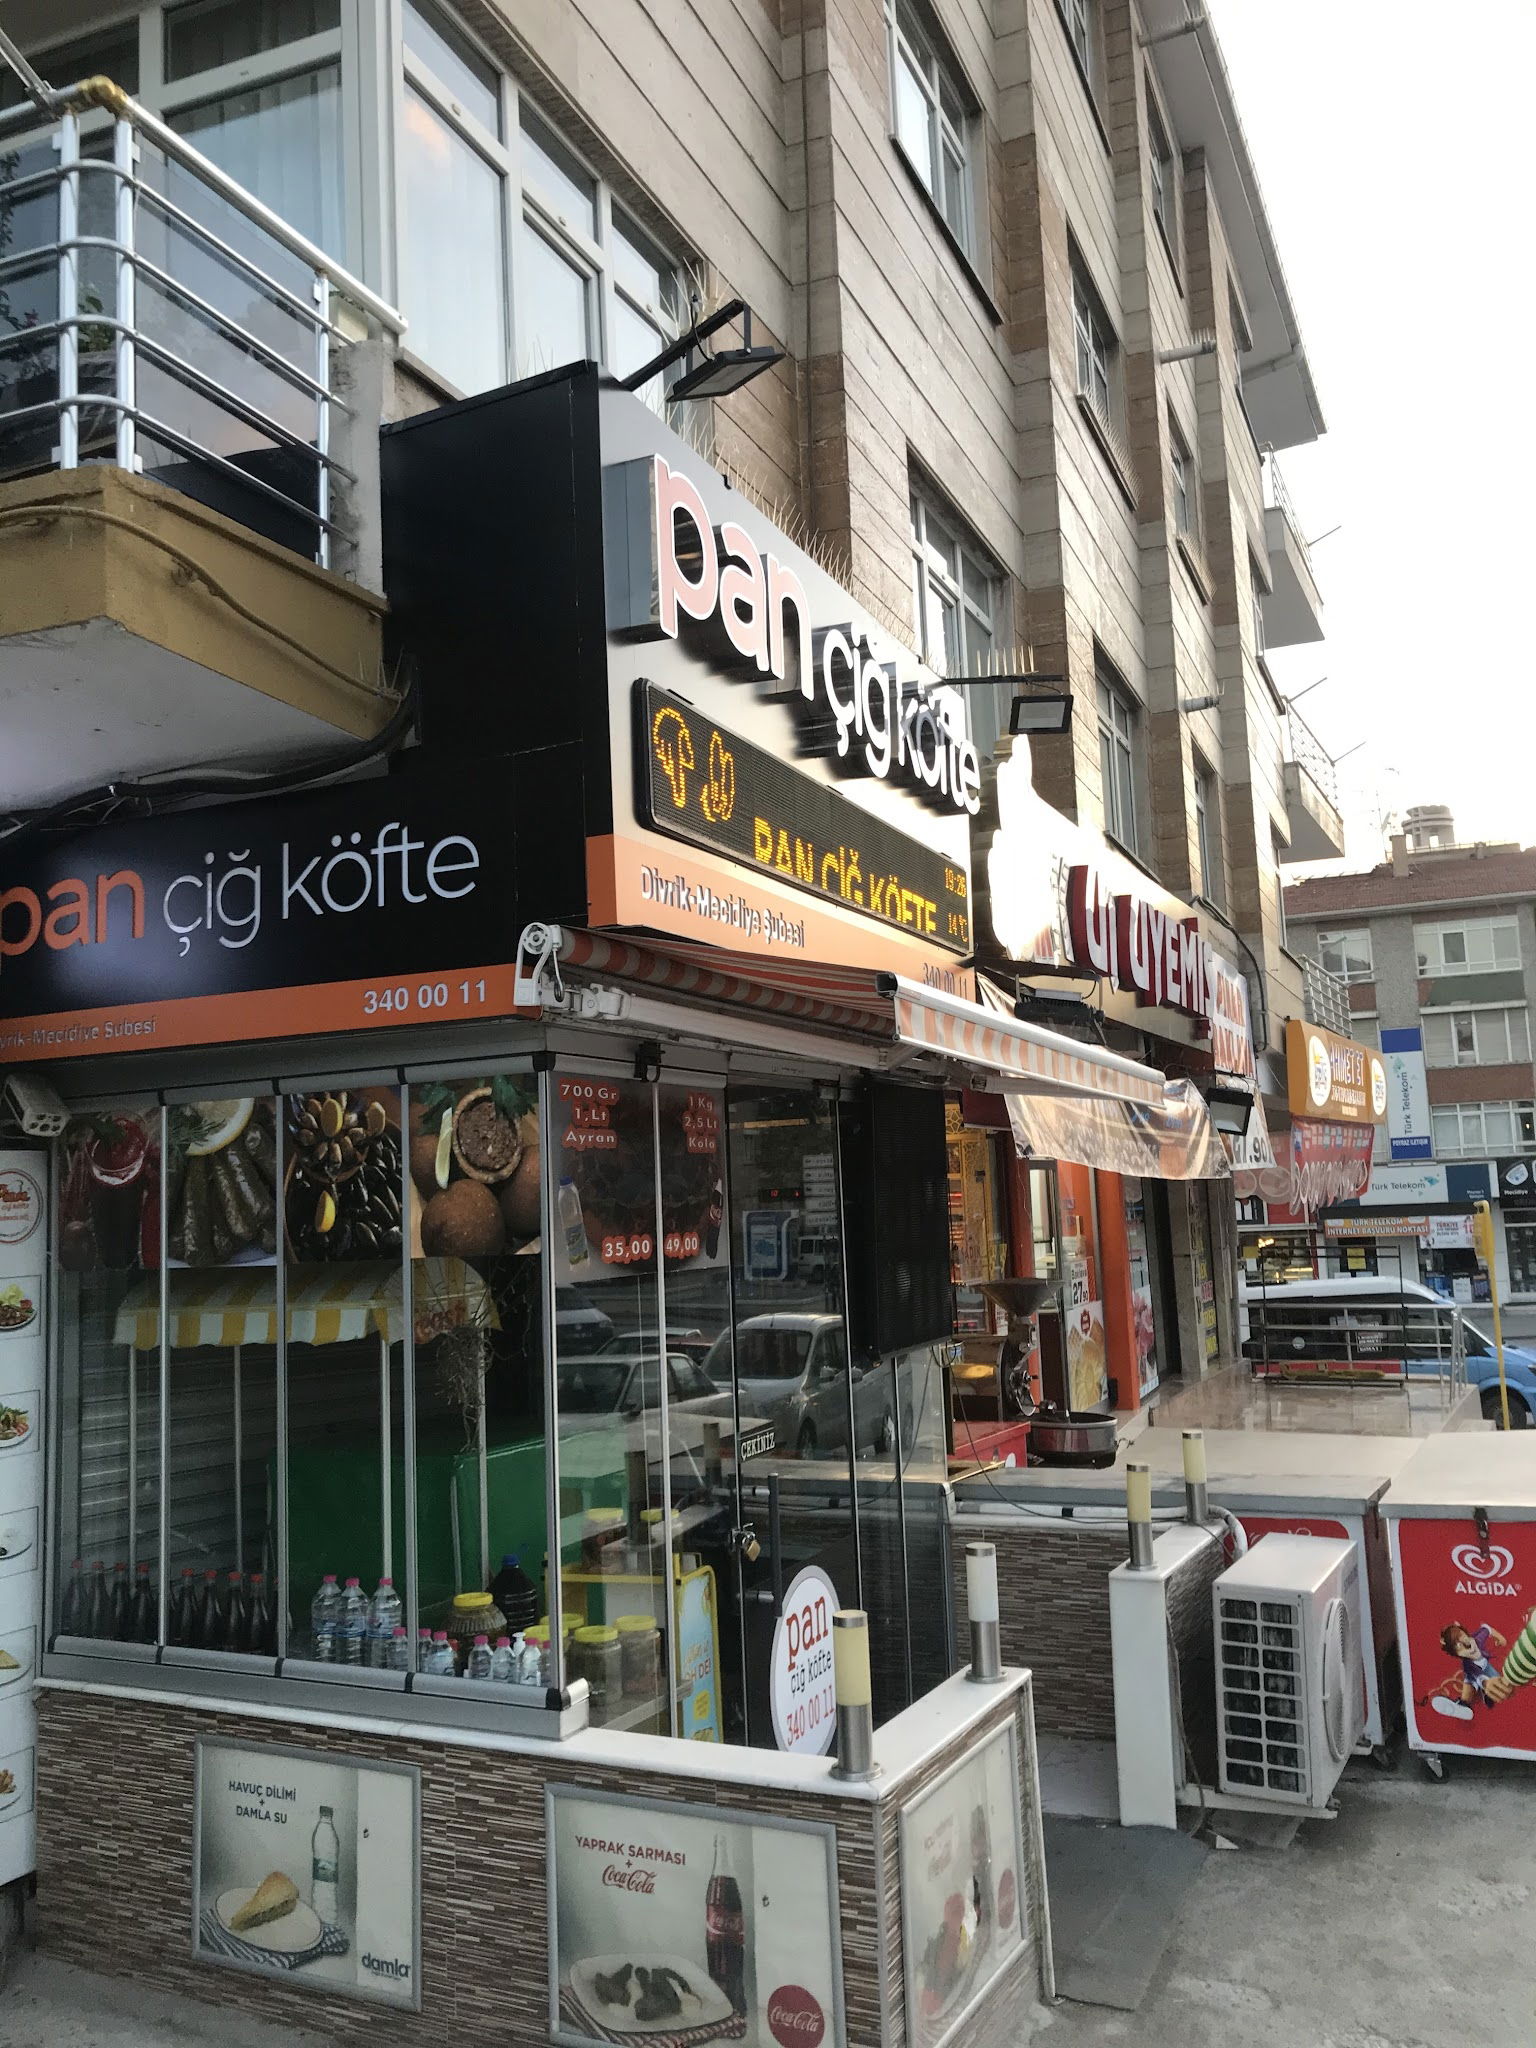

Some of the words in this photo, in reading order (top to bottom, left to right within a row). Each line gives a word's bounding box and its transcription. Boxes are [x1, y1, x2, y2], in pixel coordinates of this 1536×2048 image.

[655, 454, 814, 700] pan
[163, 848, 261, 957] çiğ
[281, 822, 480, 920] köfte
[641, 864, 762, 937] Divrik-Mecidiye
[764, 908, 805, 948] Şubesi
[363, 986, 410, 1015] 340
[417, 984, 450, 1009] 00
[459, 979, 487, 1004] 11
[561, 1084, 593, 1099] 700
[598, 1087, 617, 1100] Gr
[698, 1097, 713, 1112] Kg
[1402, 1072, 1411, 1111] Telekom
[684, 1116, 704, 1129] 2,5
[706, 1118, 717, 1129] Lt
[1404, 1111, 1413, 1135] Türk
[566, 1131, 615, 1145] Ayran
[688, 1137, 715, 1149] Kola
[1392, 1181, 1426, 1190] Telekom
[605, 1239, 650, 1258] 35,00
[666, 1237, 698, 1254] 49,00
[1073, 1281, 1083, 1304] 27
[741, 1431, 776, 1461] ÇEKİNİZ
[786, 1595, 829, 1672] pan
[790, 1665, 806, 1698] çiğ
[807, 1649, 832, 1684] köfte
[786, 1706, 805, 1747] 340
[808, 1694, 820, 1729] 00
[823, 1684, 836, 1719] 11
[228, 1780, 263, 1797] HAVUÇ
[266, 1785, 296, 1802] DİLİMİ
[236, 1805, 271, 1822] DAMLA
[274, 1811, 288, 1824] SU
[575, 1835, 625, 1855] YAPRAK
[628, 1844, 687, 1866] SARMASI
[602, 1863, 657, 1895] Coca-Cola
[361, 1952, 411, 1979] damla
[769, 2004, 821, 2034] Coca-Cola
